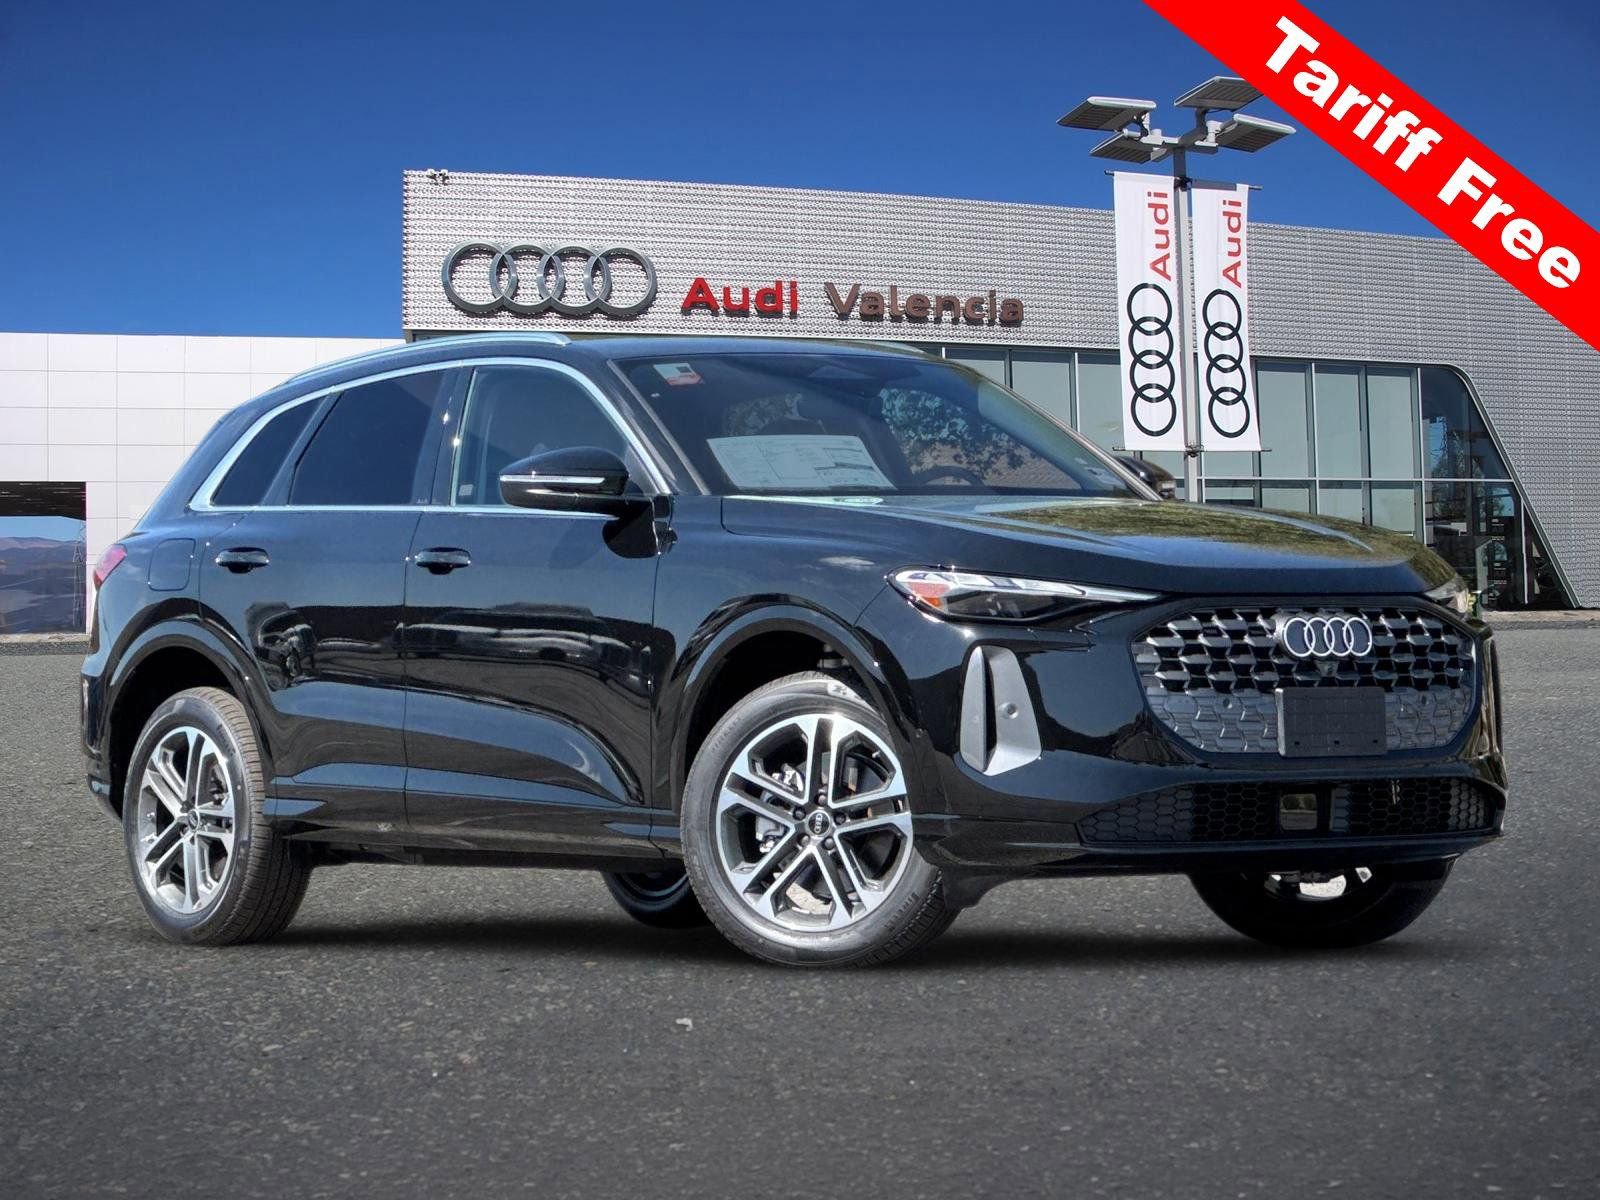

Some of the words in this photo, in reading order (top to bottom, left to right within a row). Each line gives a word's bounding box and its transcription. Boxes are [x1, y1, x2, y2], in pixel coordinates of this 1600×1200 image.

[1147, 191, 1172, 282] Audi
[1222, 199, 1242, 289] Audi
[681, 277, 799, 317] Audi
[824, 281, 1024, 326] Valencia
